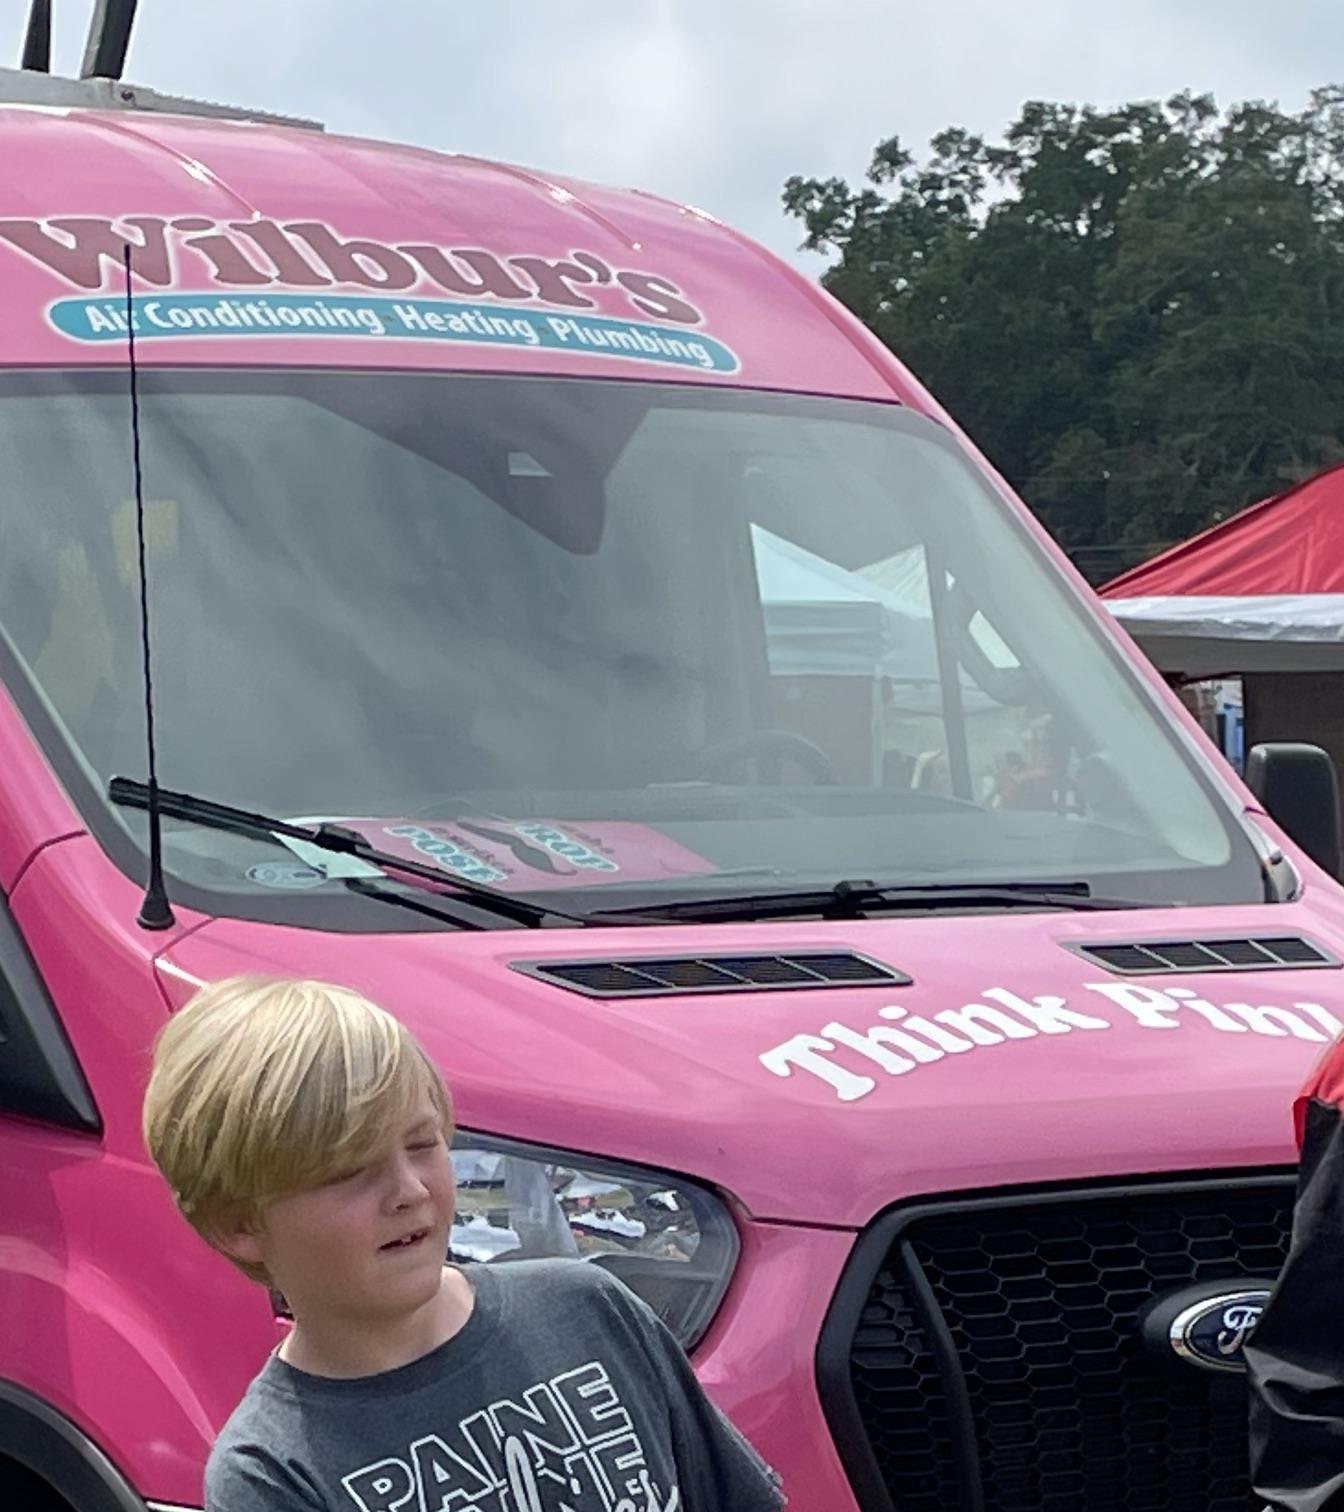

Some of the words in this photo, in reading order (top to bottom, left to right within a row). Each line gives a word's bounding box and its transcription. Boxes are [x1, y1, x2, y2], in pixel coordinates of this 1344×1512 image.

[85, 304, 140, 332] Air
[144, 300, 385, 335] Conditioning
[393, 304, 540, 345] Heating
[547, 316, 714, 368] Plumbing
[758, 986, 1111, 1102] Think
